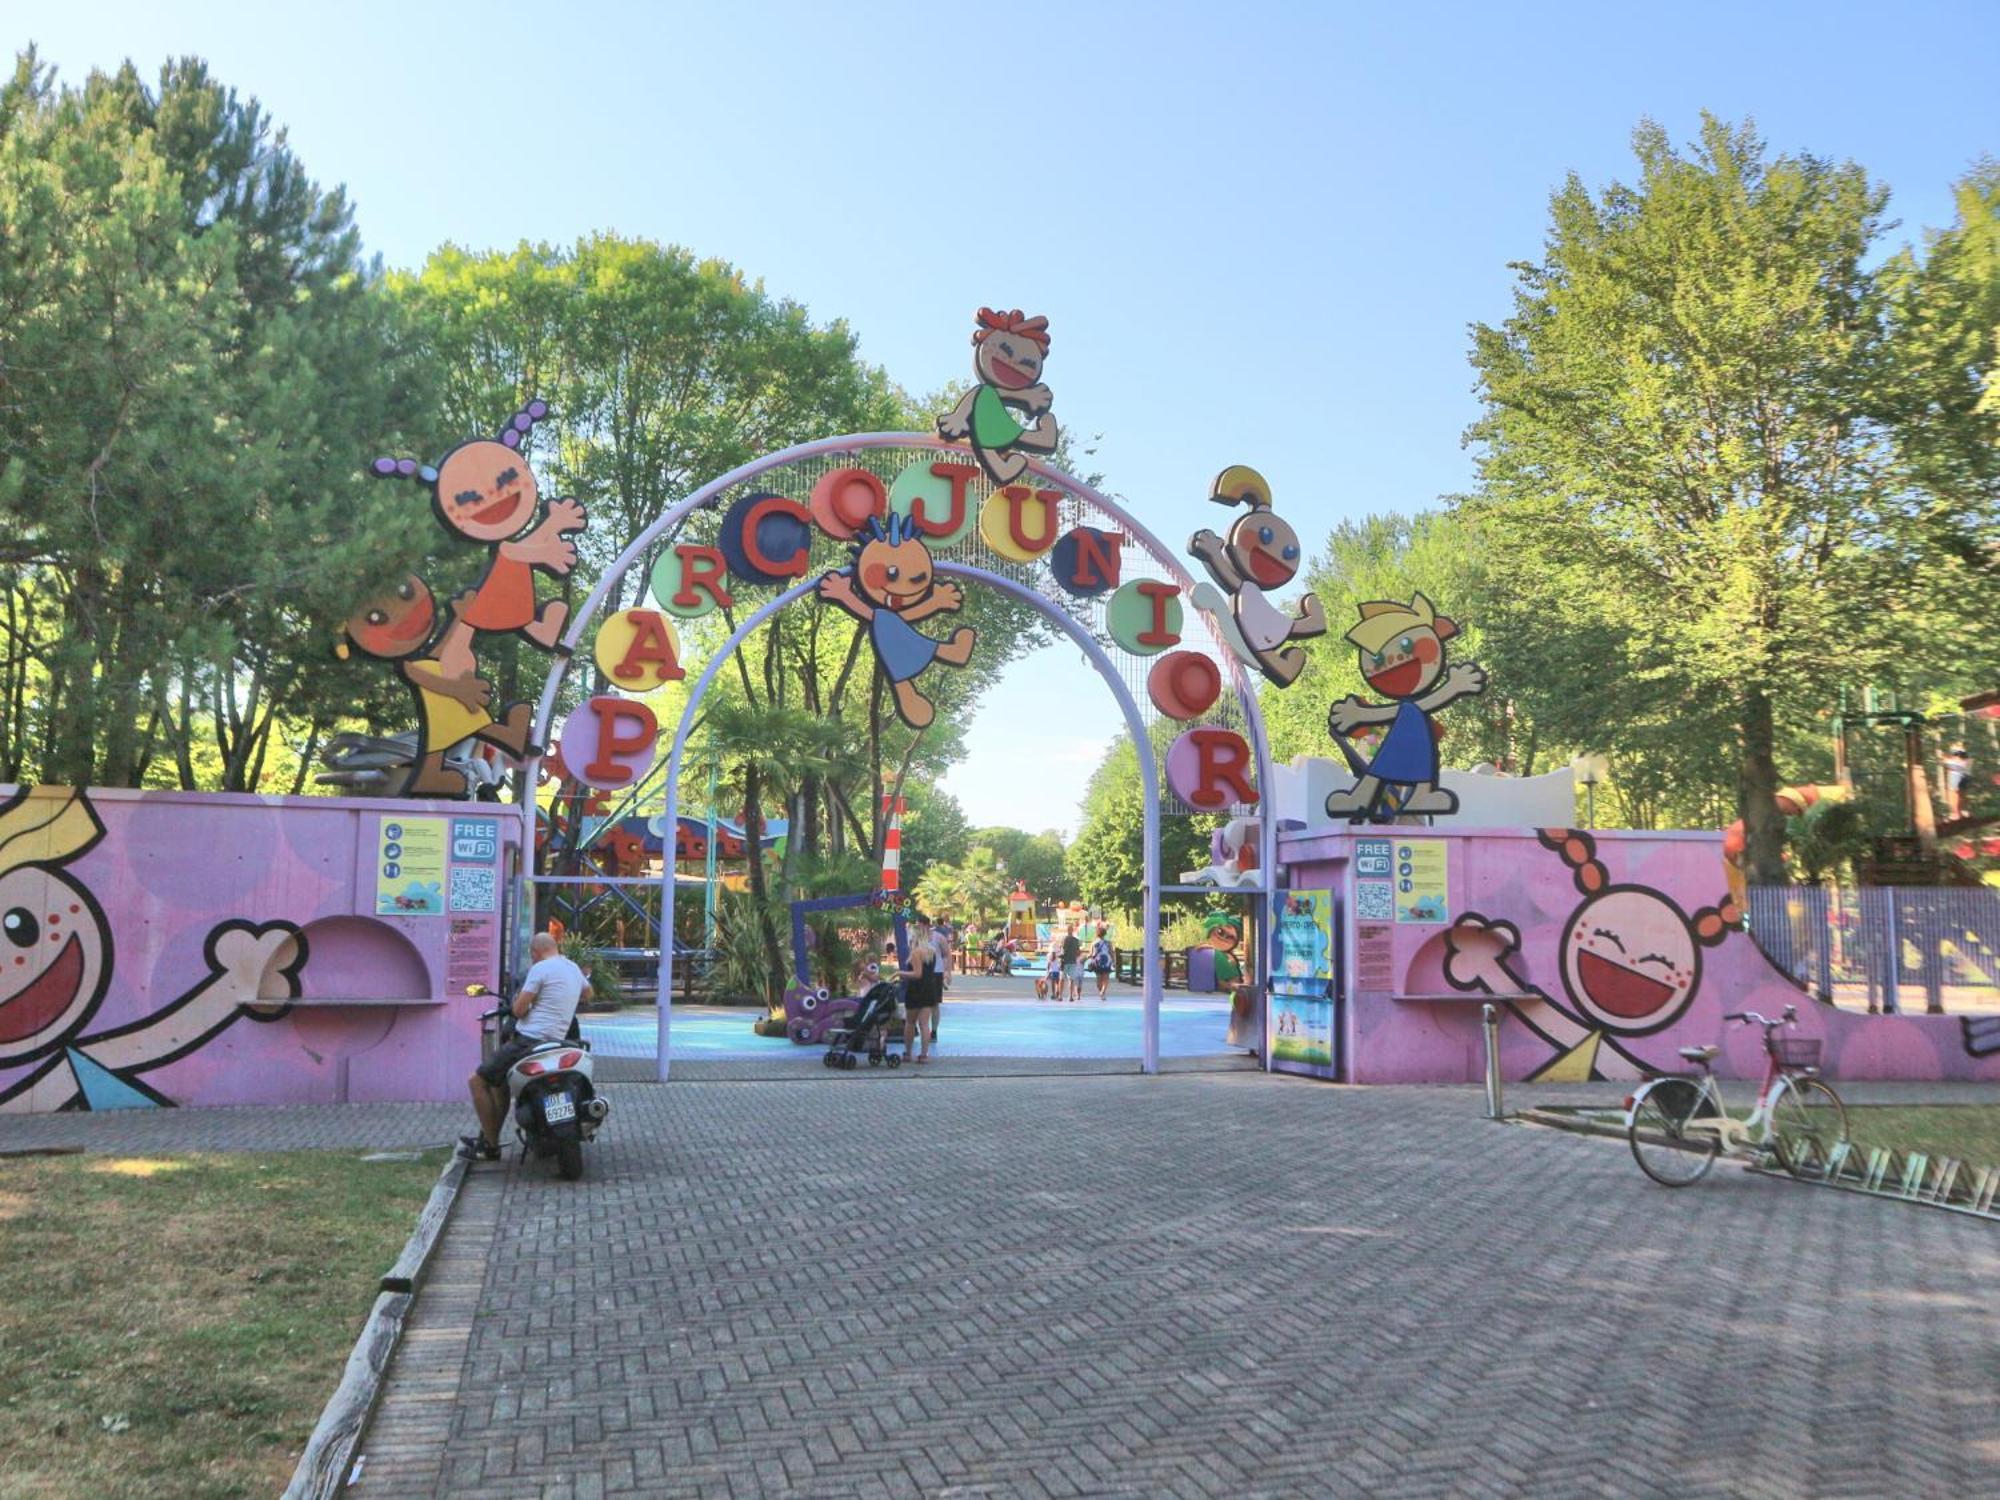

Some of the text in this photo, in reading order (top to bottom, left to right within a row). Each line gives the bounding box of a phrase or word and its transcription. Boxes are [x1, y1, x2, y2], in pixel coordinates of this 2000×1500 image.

[584, 462, 1260, 806] PARCO JUNIOR
[454, 823, 496, 837] FREE
[1356, 844, 1391, 855] FREE
